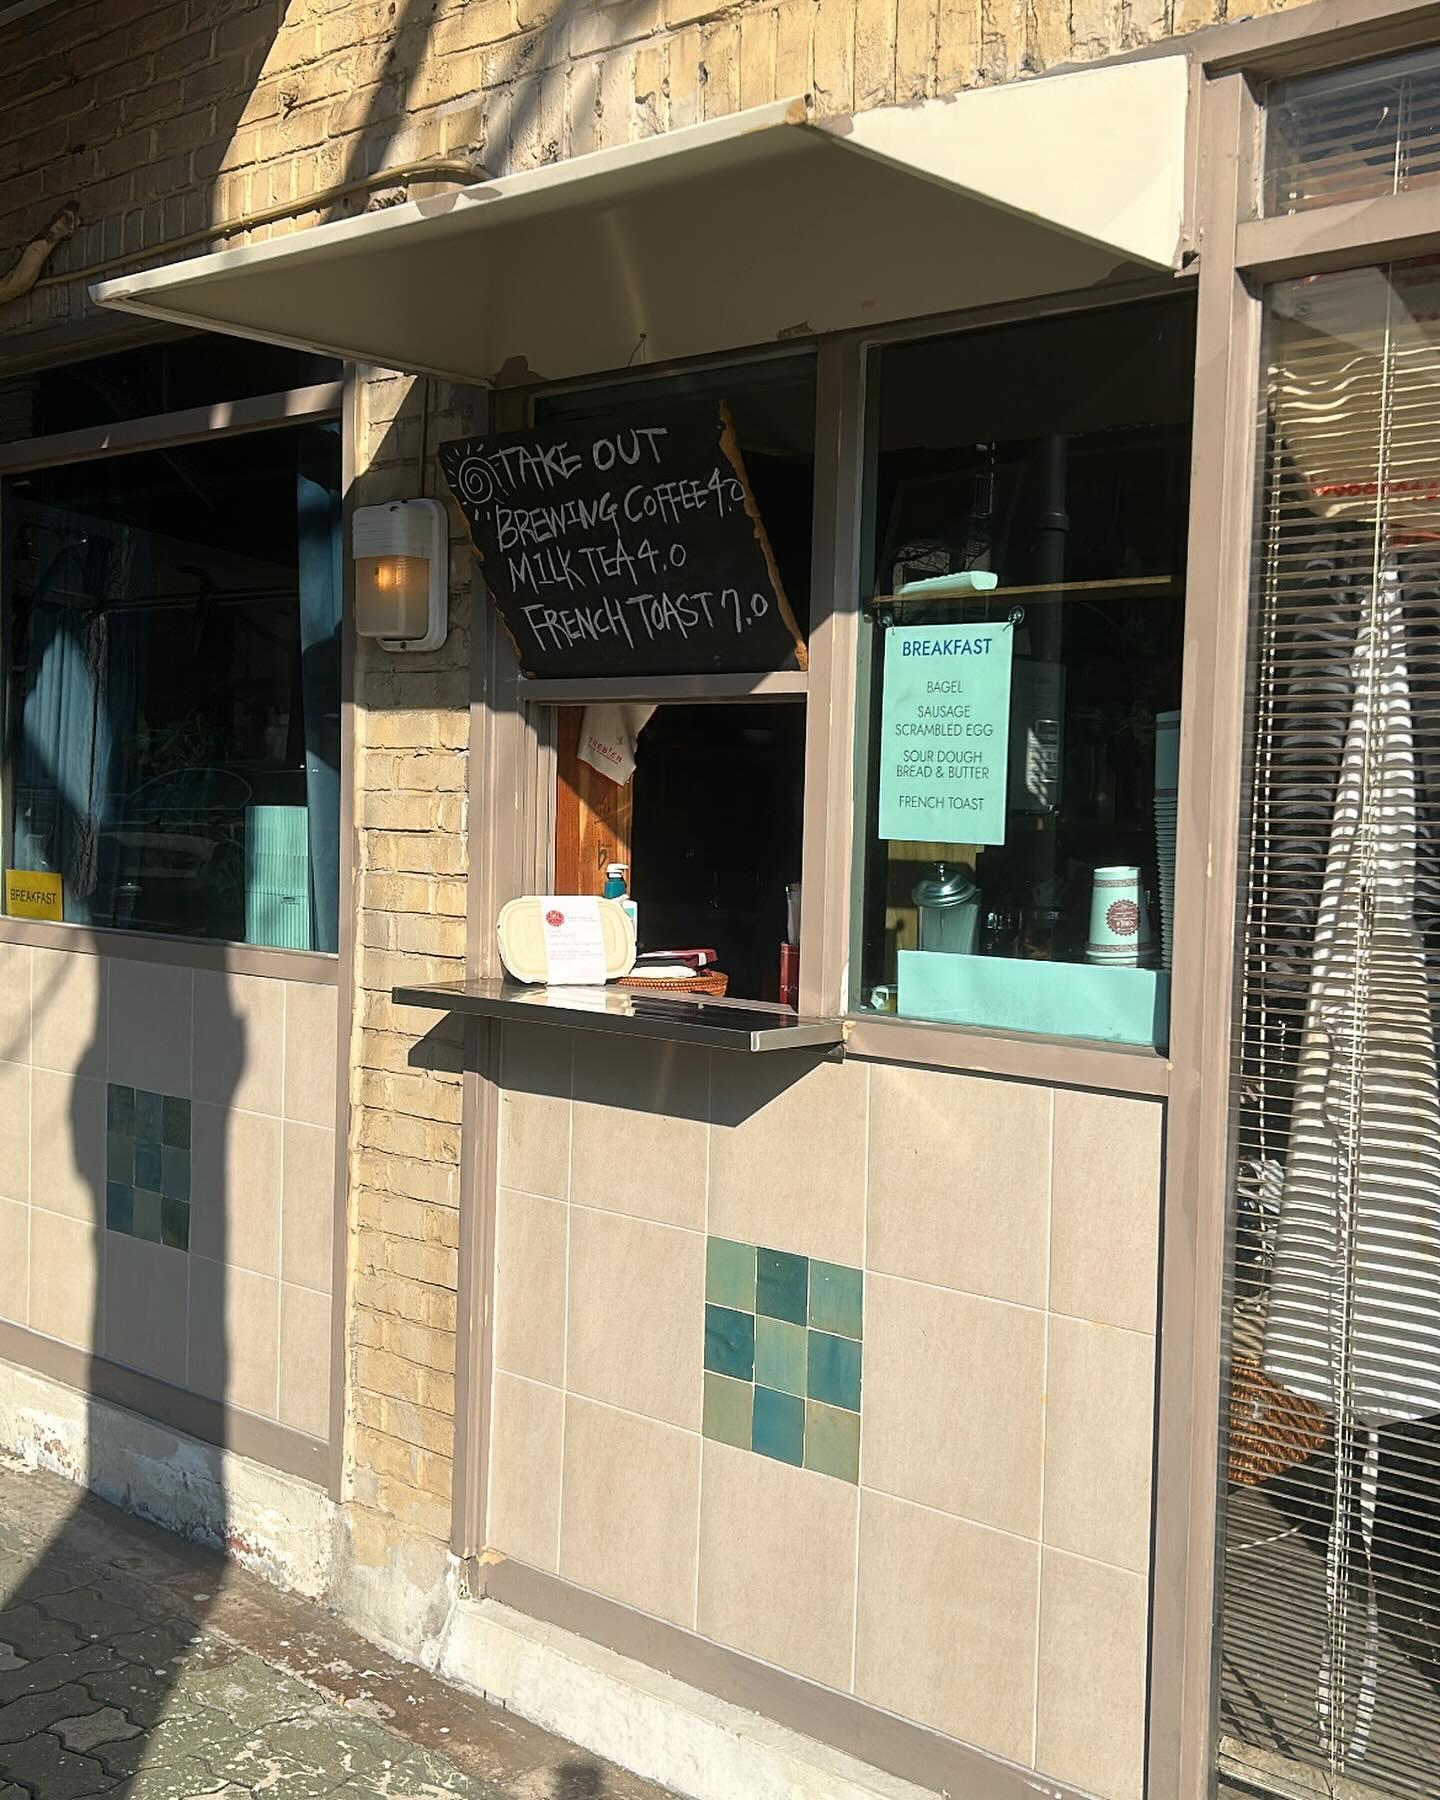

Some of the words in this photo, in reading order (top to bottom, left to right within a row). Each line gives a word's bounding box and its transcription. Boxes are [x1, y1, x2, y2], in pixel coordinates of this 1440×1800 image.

[489, 442, 582, 491] TAKE
[593, 427, 668, 471] OUT
[496, 492, 619, 552] BREWING
[708, 467, 745, 518] 4.0
[508, 545, 586, 595] MILK
[578, 538, 638, 585] TEA
[638, 539, 686, 575] 4.0
[520, 596, 634, 651] FRENCH
[626, 592, 714, 640] TOAST
[721, 588, 768, 633] 7.0
[902, 638, 992, 657] BREAKFAST
[926, 680, 963, 694] BAGEL
[917, 705, 971, 718] SAUSAGE
[895, 723, 963, 737] SCRAMBLED
[966, 723, 993, 737] EGG
[903, 750, 934, 763] SOUR
[937, 750, 983, 764] DOUGH
[896, 765, 933, 778] BREAD
[935, 766, 944, 778] &
[948, 766, 989, 779] BUTTER
[899, 796, 945, 809] FRENCH
[948, 797, 985, 810] TOAST
[10, 889, 56, 904] BREAKFAST
